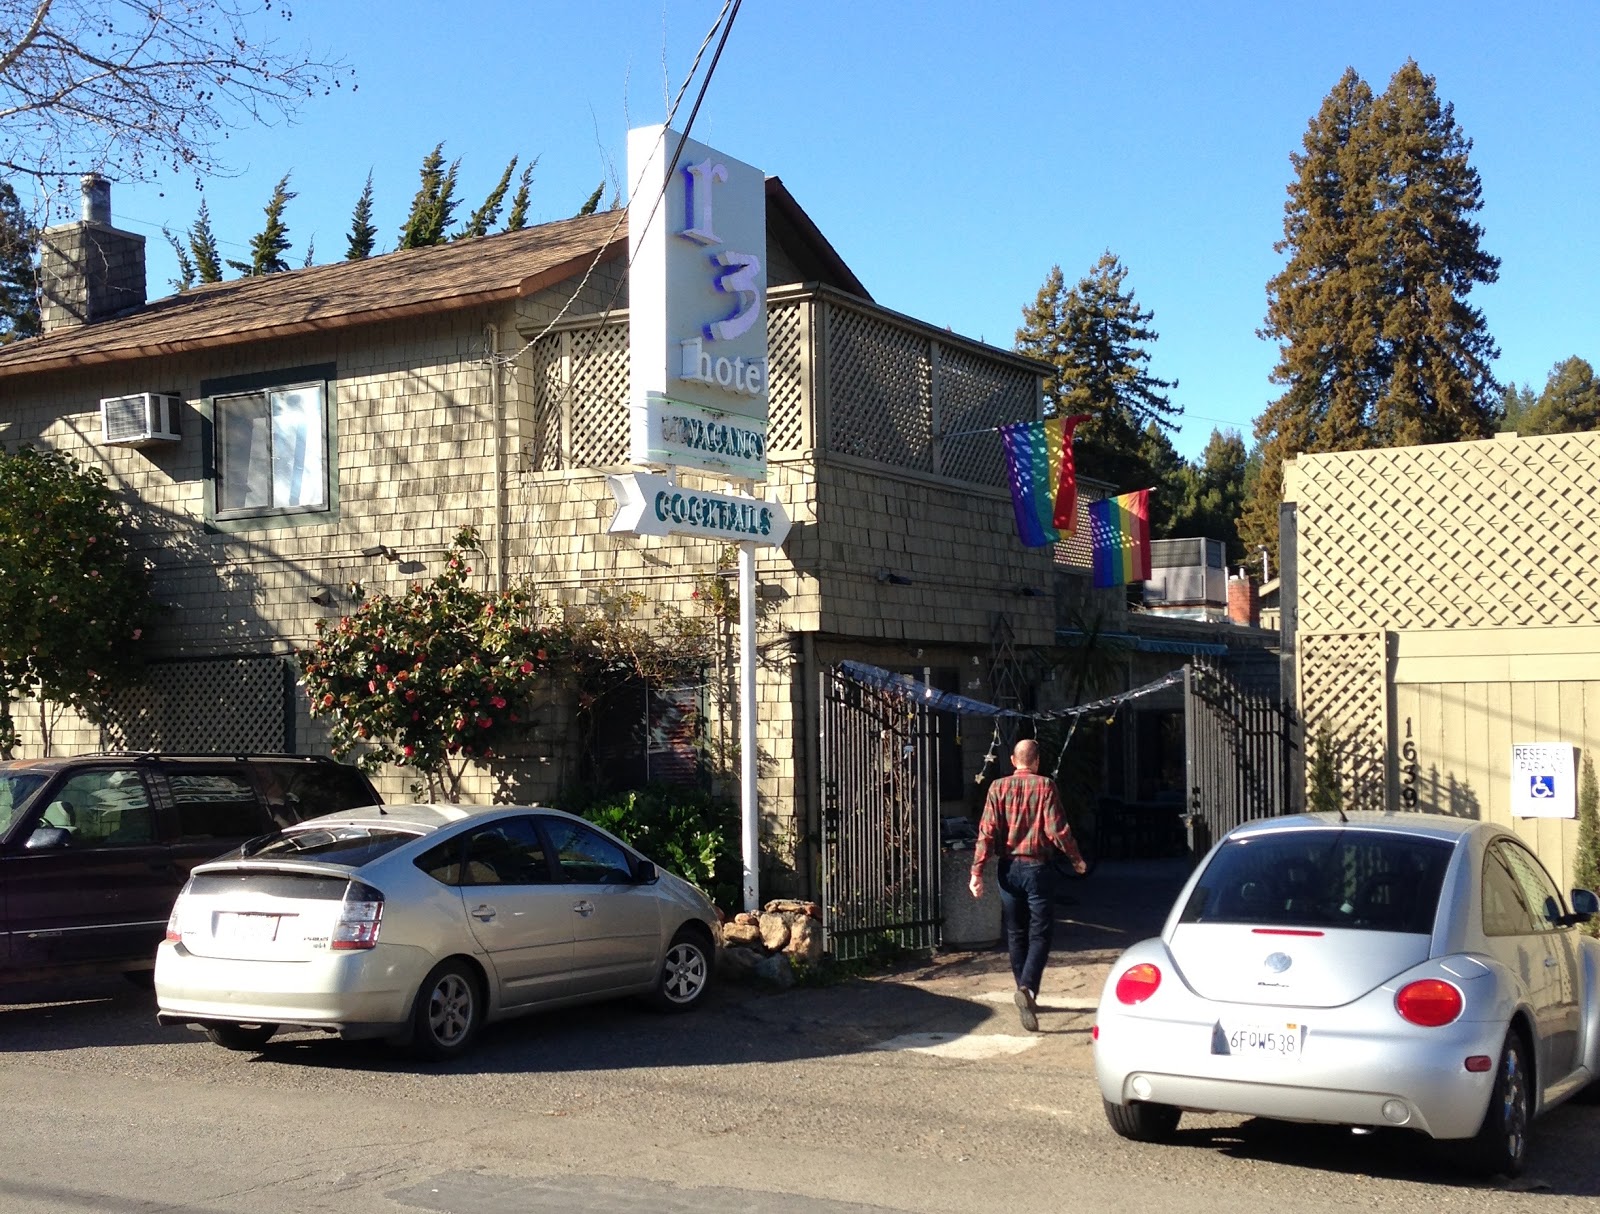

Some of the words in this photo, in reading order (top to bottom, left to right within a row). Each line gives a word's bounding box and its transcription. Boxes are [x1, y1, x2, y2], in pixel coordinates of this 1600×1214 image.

[682, 337, 768, 397] hotel
[682, 417, 766, 461] VACANCY
[655, 491, 773, 535] COCKTAILS
[1402, 717, 1418, 808] 1639
[1515, 748, 1565, 760] RESERE
